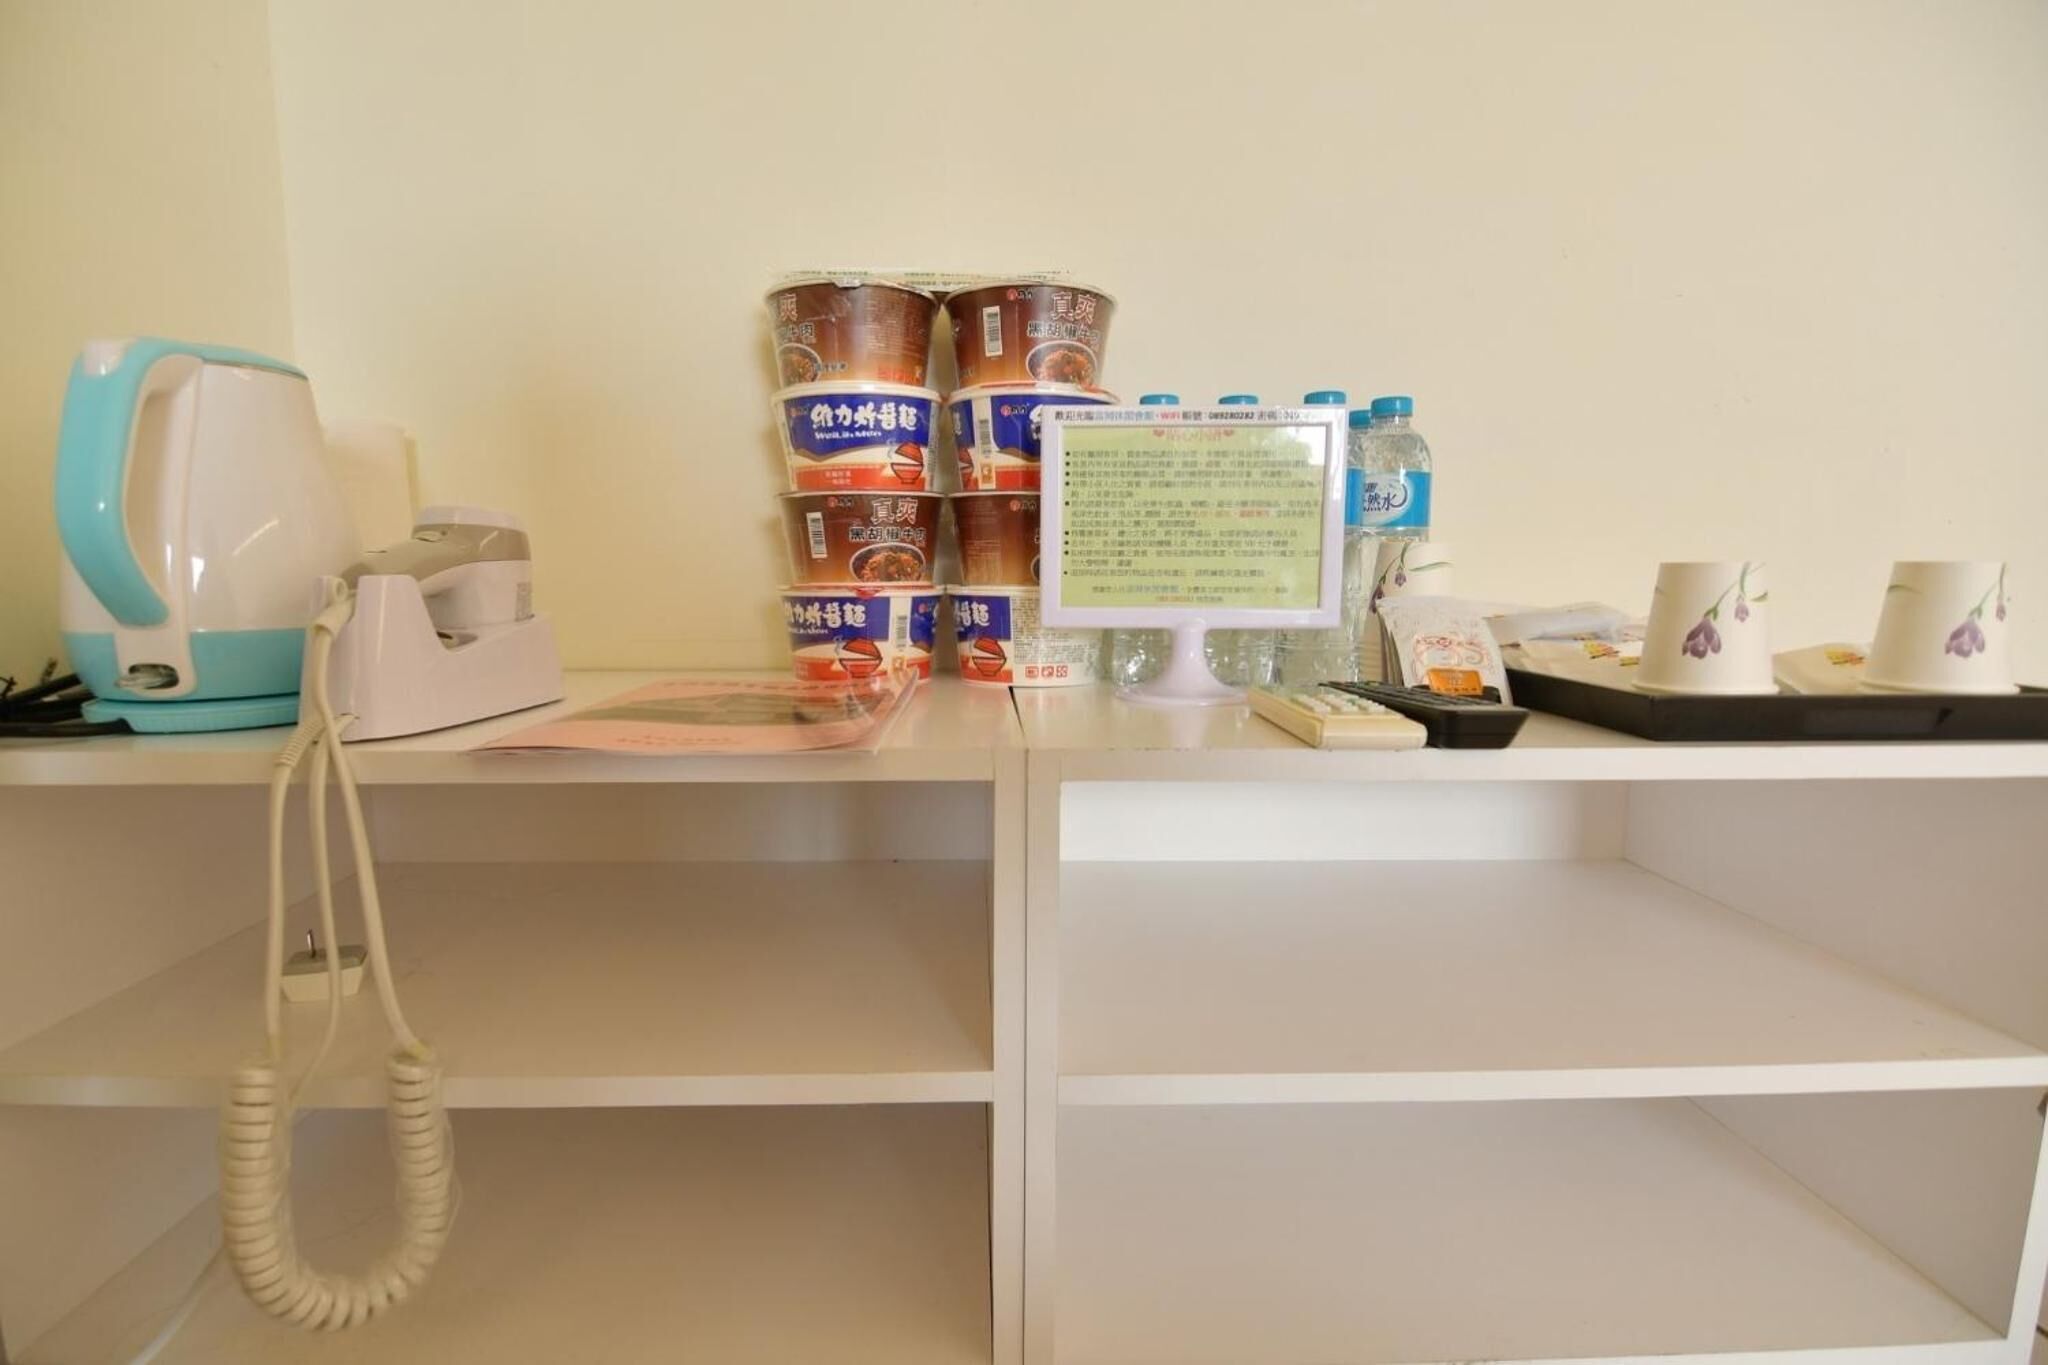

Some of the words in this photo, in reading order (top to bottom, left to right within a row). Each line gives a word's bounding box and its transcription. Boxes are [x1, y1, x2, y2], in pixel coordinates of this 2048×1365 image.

[1050, 291, 1097, 325] 真爽
[810, 401, 918, 431] 維力炸醬麵
[871, 497, 919, 525] 真爽
